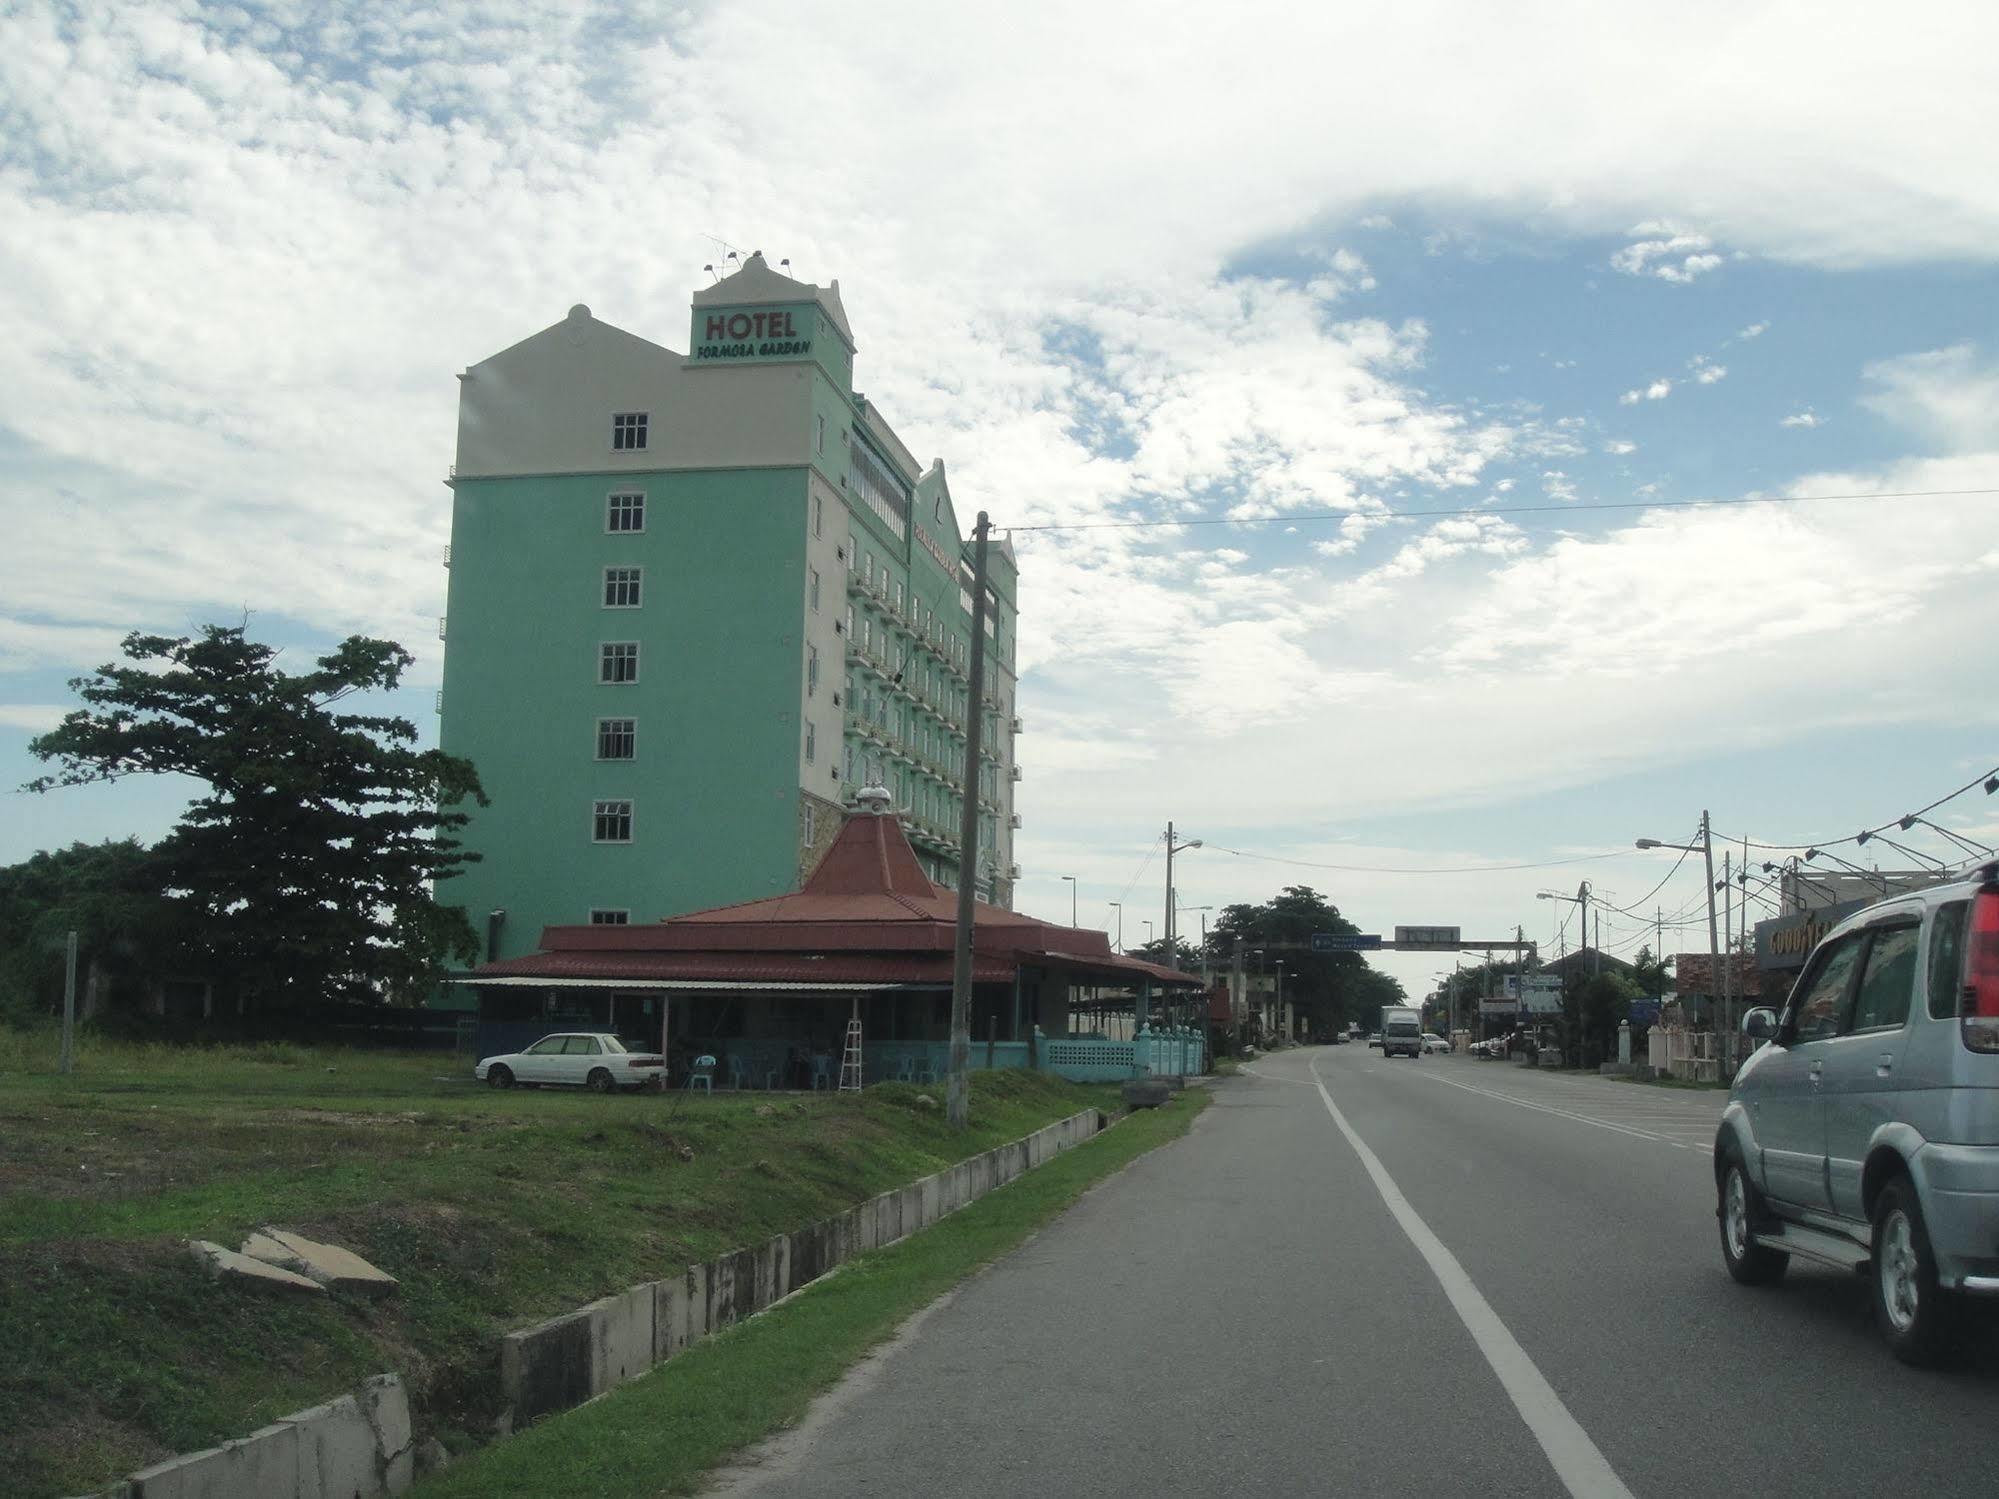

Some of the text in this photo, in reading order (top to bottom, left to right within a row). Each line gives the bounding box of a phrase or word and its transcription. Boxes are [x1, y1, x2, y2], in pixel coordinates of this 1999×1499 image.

[706, 312, 796, 340] HOTEL
[697, 341, 811, 359] FORMOSA GARDEN
